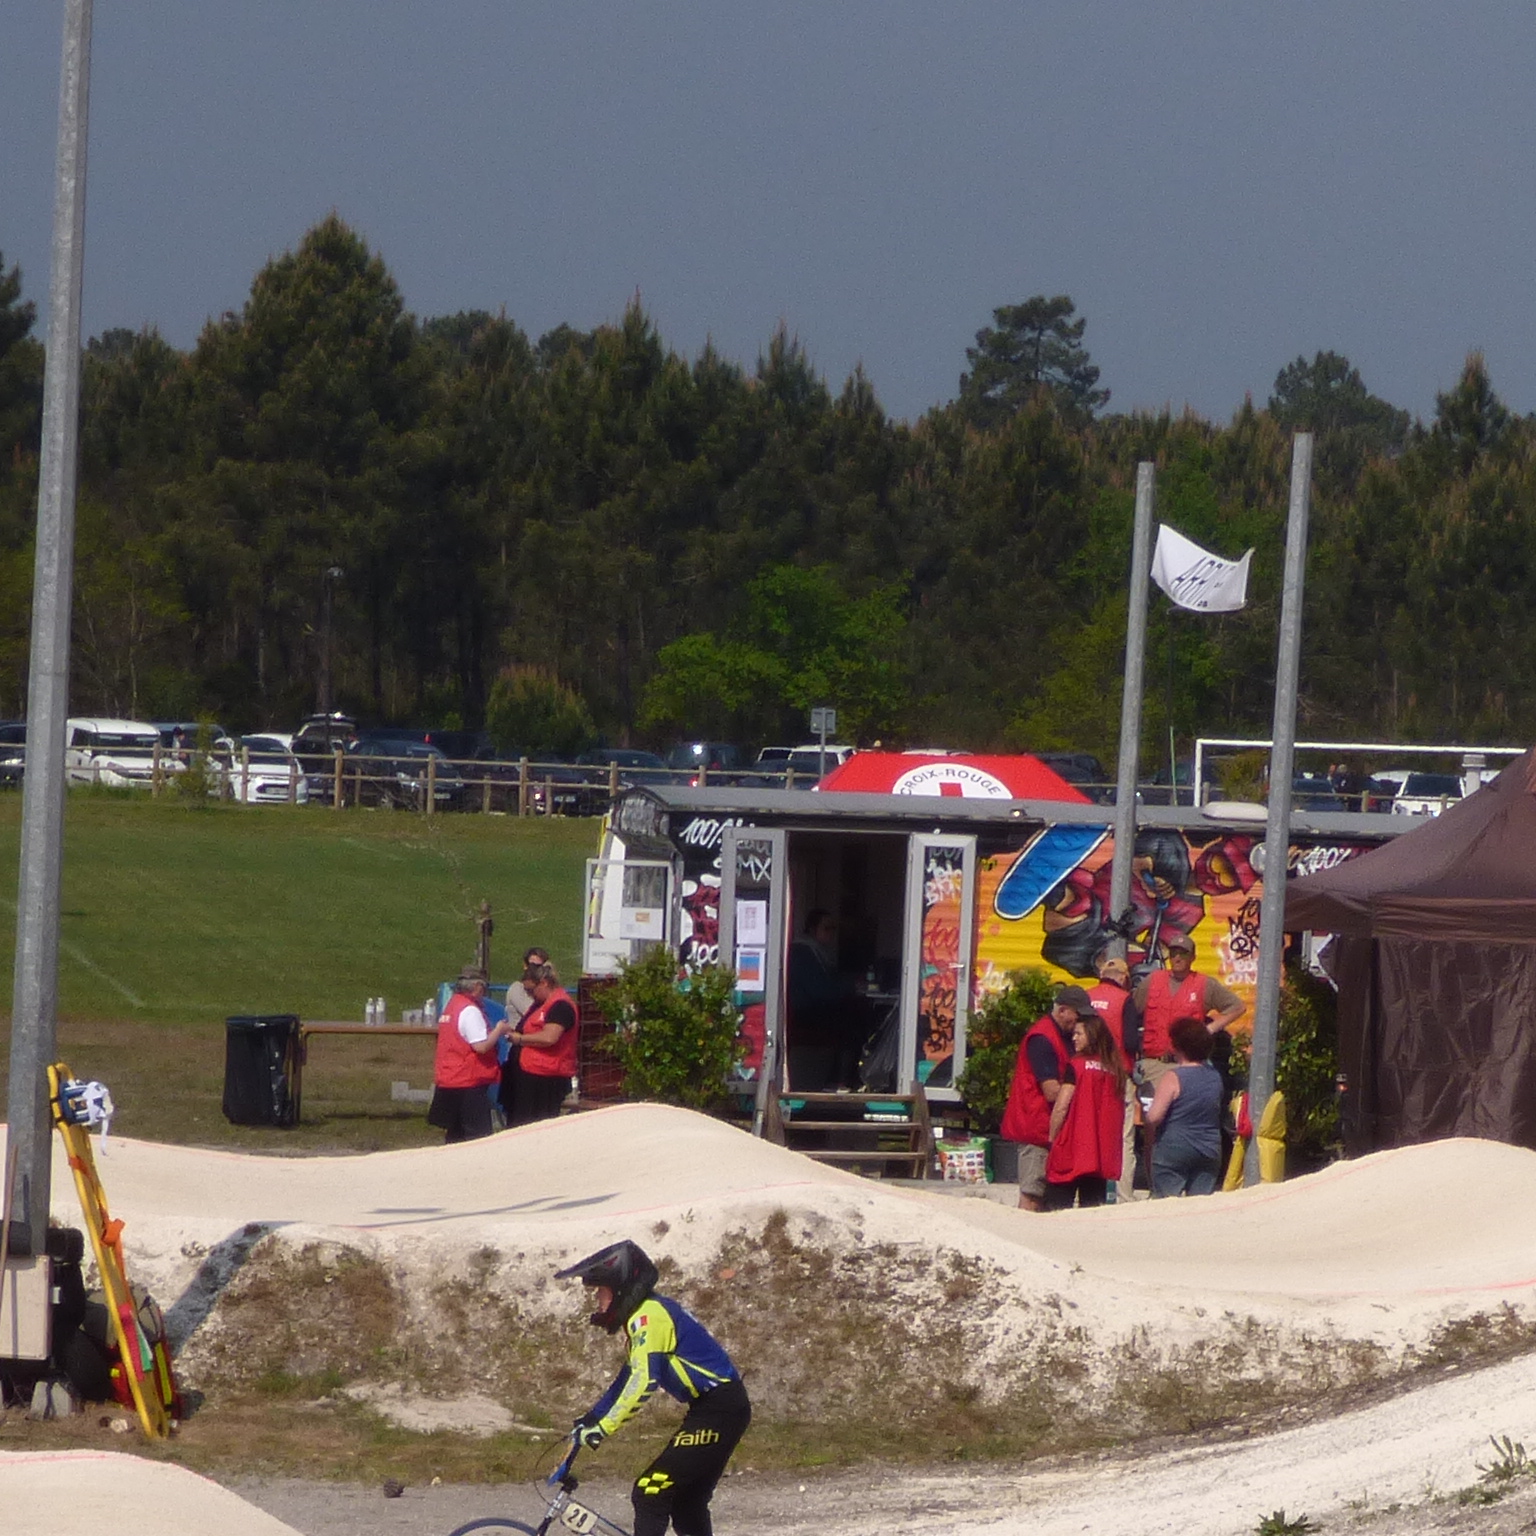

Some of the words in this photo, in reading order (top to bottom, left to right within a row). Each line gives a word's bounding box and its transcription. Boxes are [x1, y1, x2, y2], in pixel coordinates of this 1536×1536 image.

[899, 768, 1002, 796] CROIX-ROUGE
[674, 1429, 719, 1448] faith
[567, 1508, 588, 1528] 29
